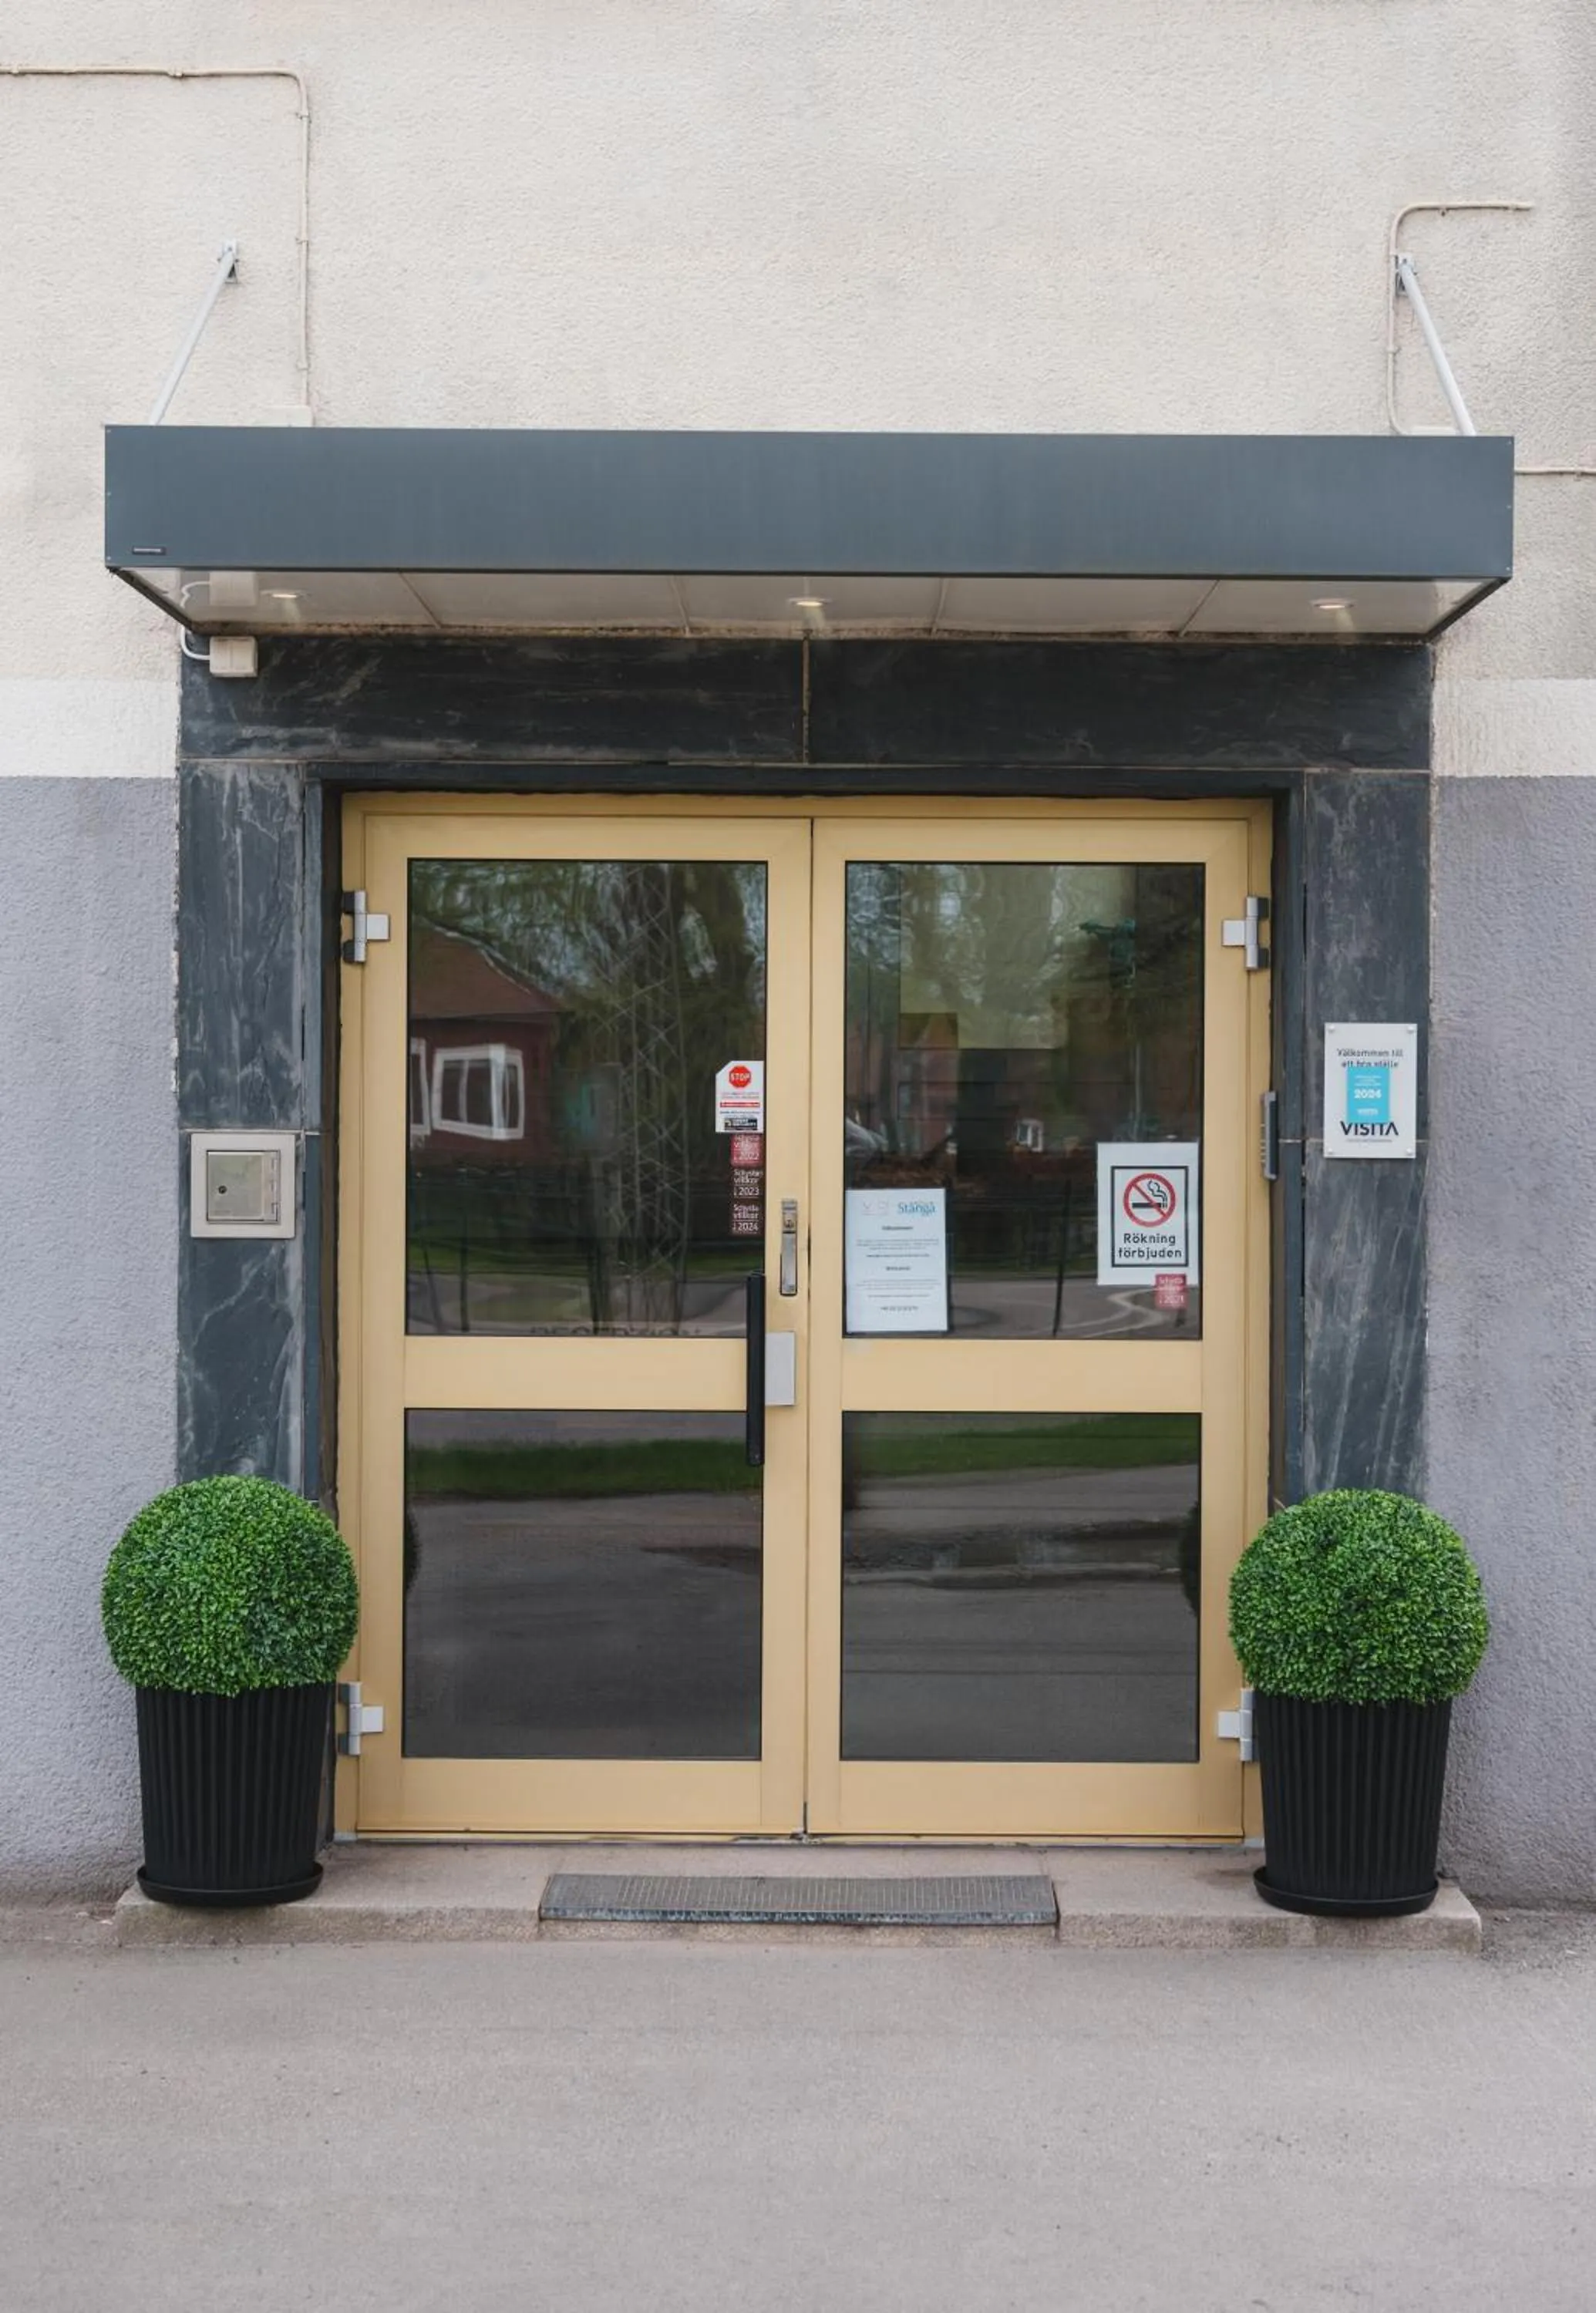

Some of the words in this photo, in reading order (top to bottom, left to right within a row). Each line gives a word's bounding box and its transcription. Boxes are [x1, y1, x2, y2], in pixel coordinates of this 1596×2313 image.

[1336, 1048, 1389, 1057] Välkommen
[730, 1072, 750, 1081] STOP
[1339, 1120, 1399, 1136] VISITA
[739, 1187, 759, 1196] 2023
[738, 1223, 759, 1231] 2024
[1123, 1233, 1176, 1246] Rökning
[1118, 1247, 1182, 1260] förbjuden
